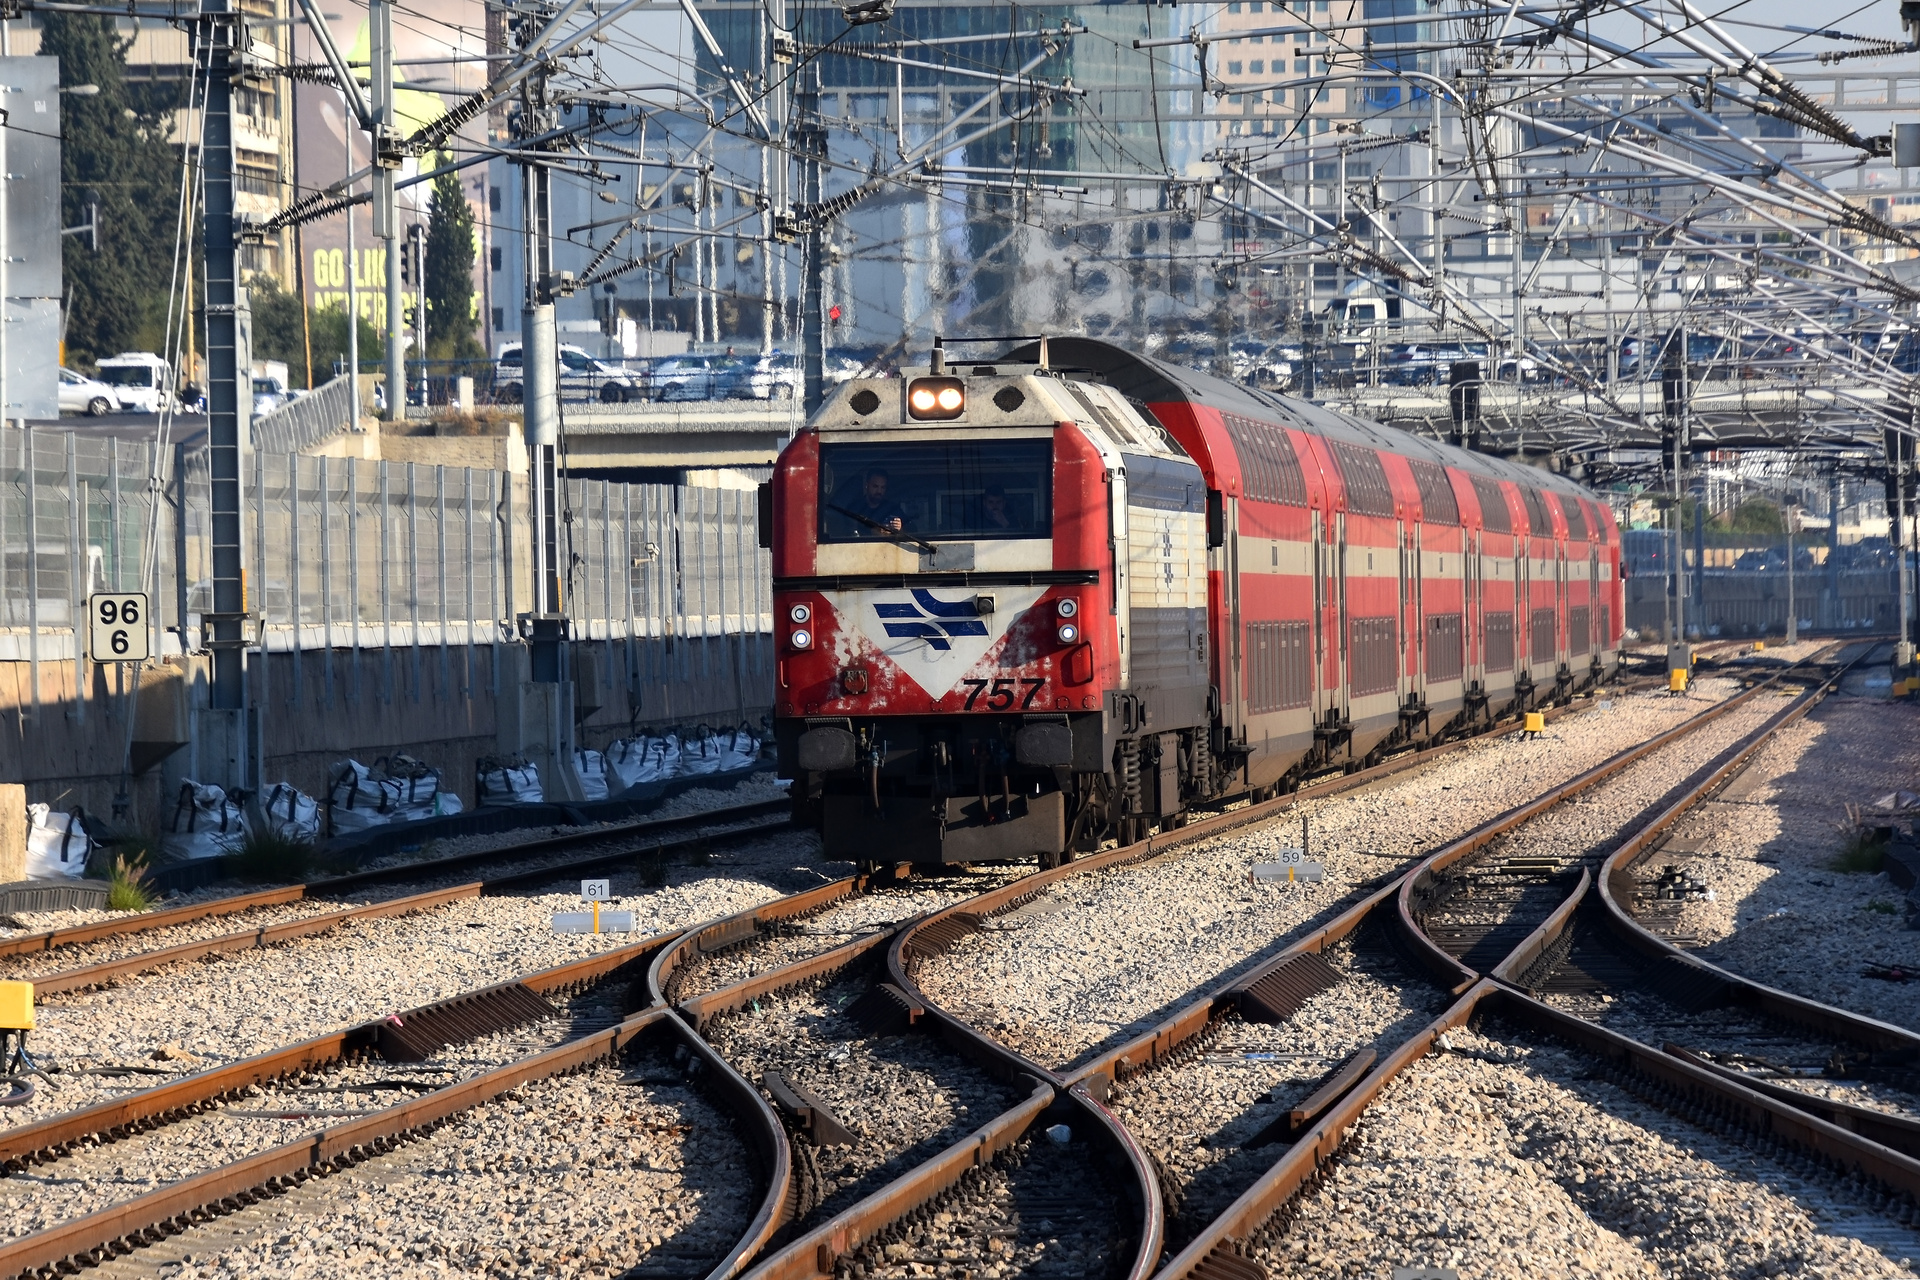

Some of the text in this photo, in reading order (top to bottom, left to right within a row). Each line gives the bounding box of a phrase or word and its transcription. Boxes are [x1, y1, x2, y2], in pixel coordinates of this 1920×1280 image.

[314, 248, 387, 287] GO LIK
[99, 599, 139, 625] 96
[111, 629, 129, 654] 6
[963, 679, 1046, 711] 757
[1282, 852, 1300, 863] 59
[588, 884, 603, 896] 61
